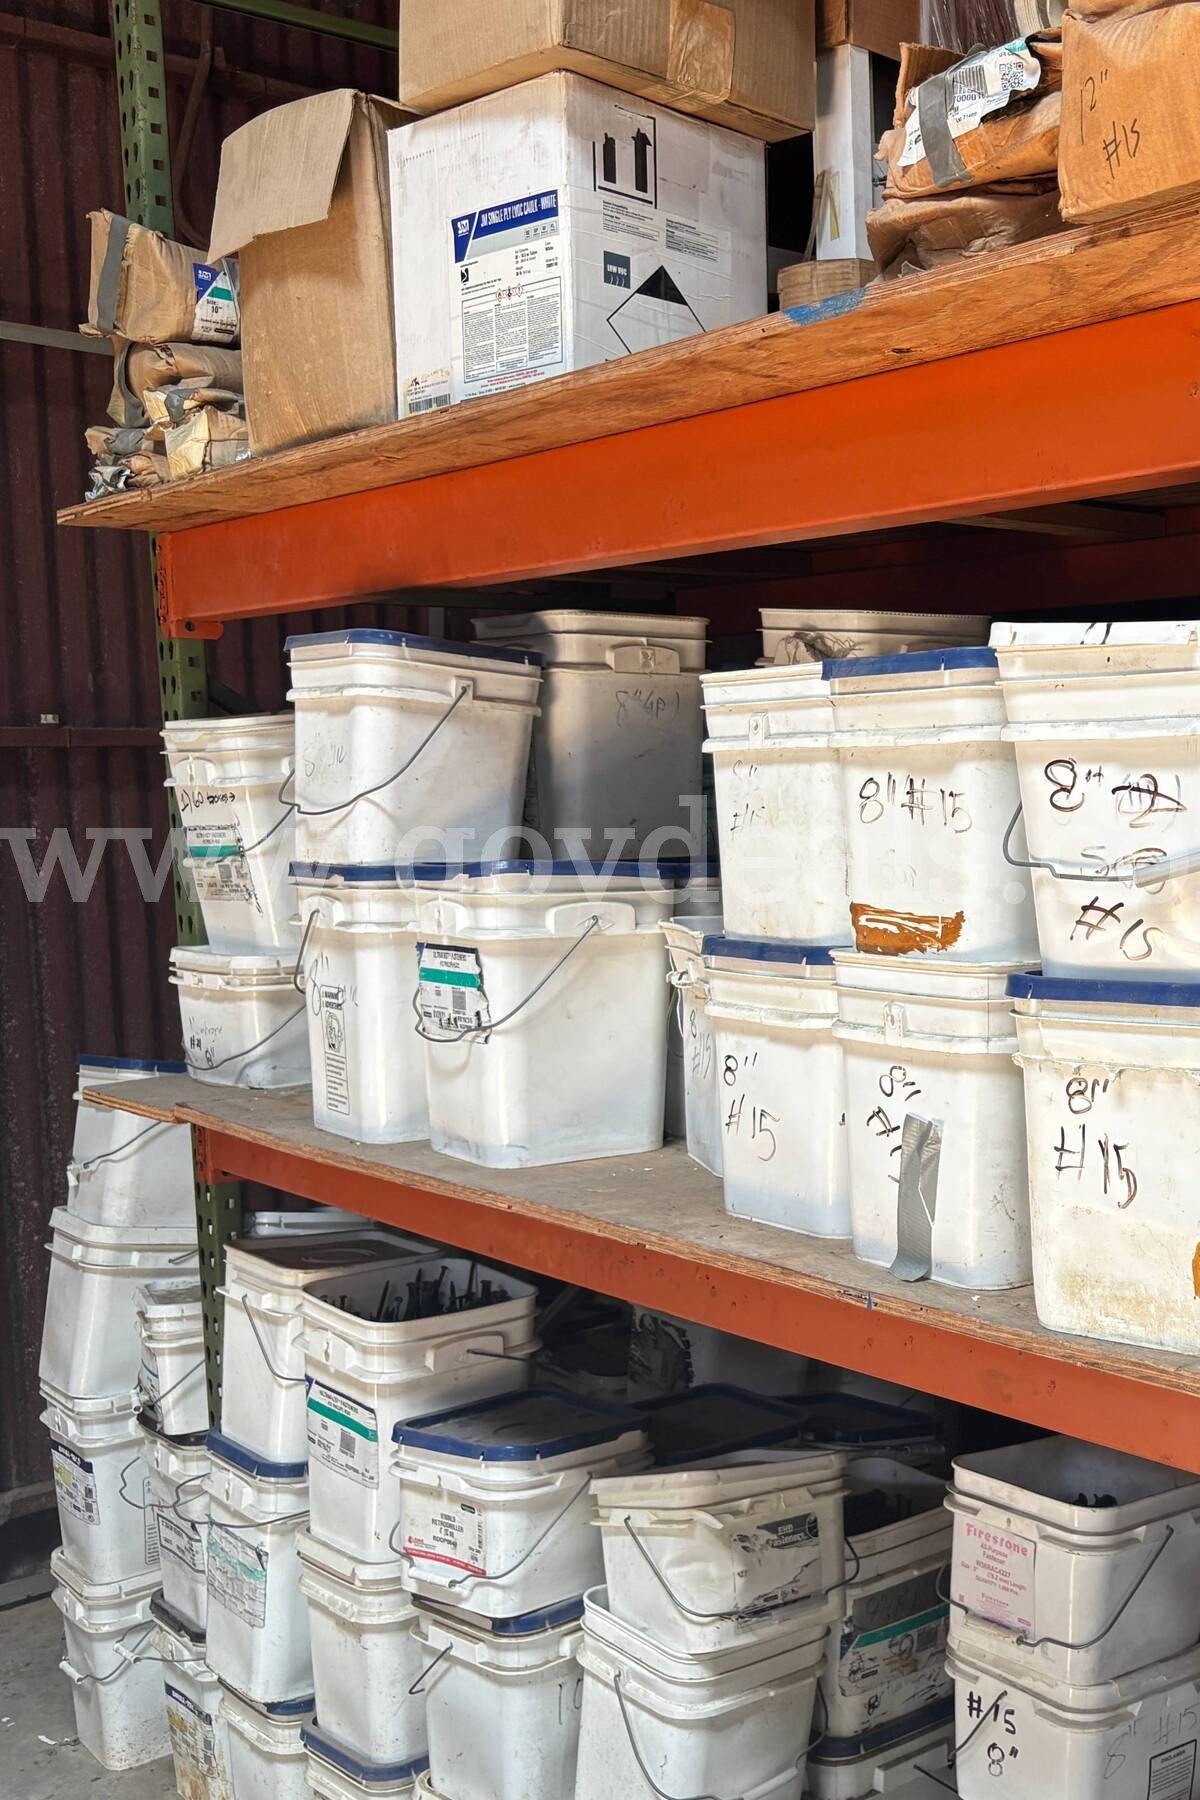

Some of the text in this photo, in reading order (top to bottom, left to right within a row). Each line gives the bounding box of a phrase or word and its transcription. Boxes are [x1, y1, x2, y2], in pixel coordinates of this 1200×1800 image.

[1080, 68, 1108, 145] 12"
[1102, 118, 1140, 179] #15
[481, 213, 489, 227] JM
[488, 210, 504, 226] SINGLE
[503, 206, 512, 220] PLY
[524, 199, 538, 215] CAULK
[540, 194, 556, 210] WHITE
[607, 264, 628, 276] LOW VOC
[859, 772, 973, 833] 8" #15
[723, 1052, 758, 1087] 8"
[1066, 1077, 1109, 1114] 8"
[725, 1094, 780, 1162] #15
[1053, 1123, 1138, 1209] #15
[966, 1523, 1029, 1557] Firestone
[967, 1690, 1016, 1735] #15
[1152, 1702, 1200, 1745] #15
[987, 1742, 1019, 1777] 8"
